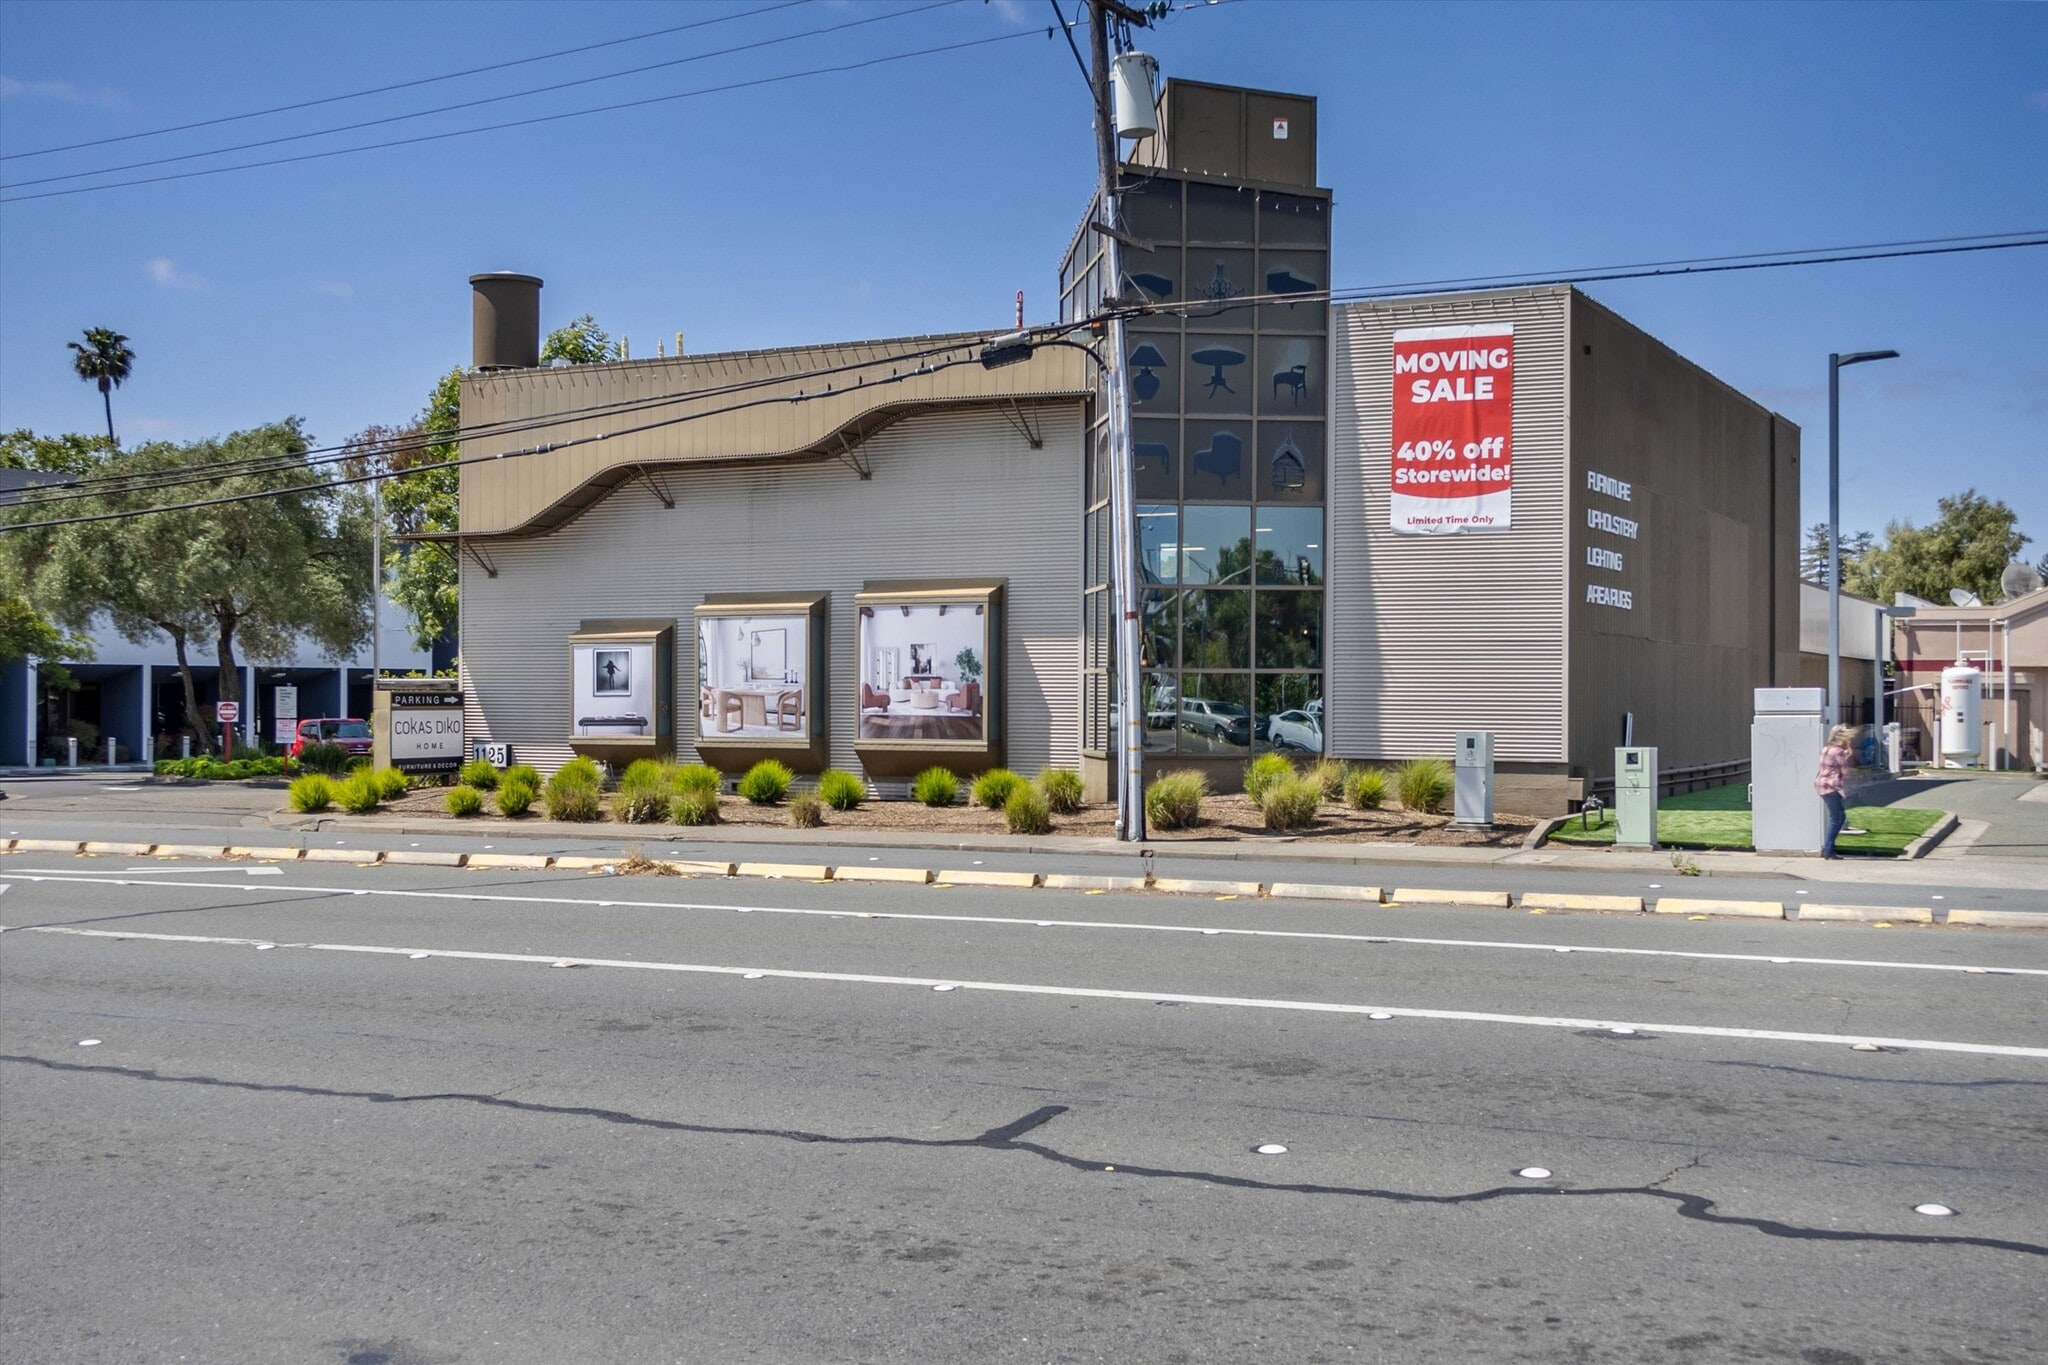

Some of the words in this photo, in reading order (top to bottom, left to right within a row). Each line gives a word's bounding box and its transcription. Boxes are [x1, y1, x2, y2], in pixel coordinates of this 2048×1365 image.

[1395, 348, 1509, 374] MOVING
[1411, 376, 1494, 403] SALE
[1396, 439, 1456, 461] 40%
[1463, 436, 1504, 459] off
[1395, 464, 1511, 484] Storewide!
[1587, 470, 1632, 502] FURNITURE
[1407, 516, 1443, 525] Limited
[1446, 515, 1469, 524] Time
[1472, 515, 1494, 525] Only
[1587, 508, 1639, 539] UPHOLSTERY
[1586, 546, 1622, 571] LIGHTING
[395, 696, 440, 704] PARKING
[395, 717, 433, 735] COKAS
[436, 717, 461, 734] DIKO
[416, 742, 444, 750] HOME
[475, 746, 505, 764] 1125
